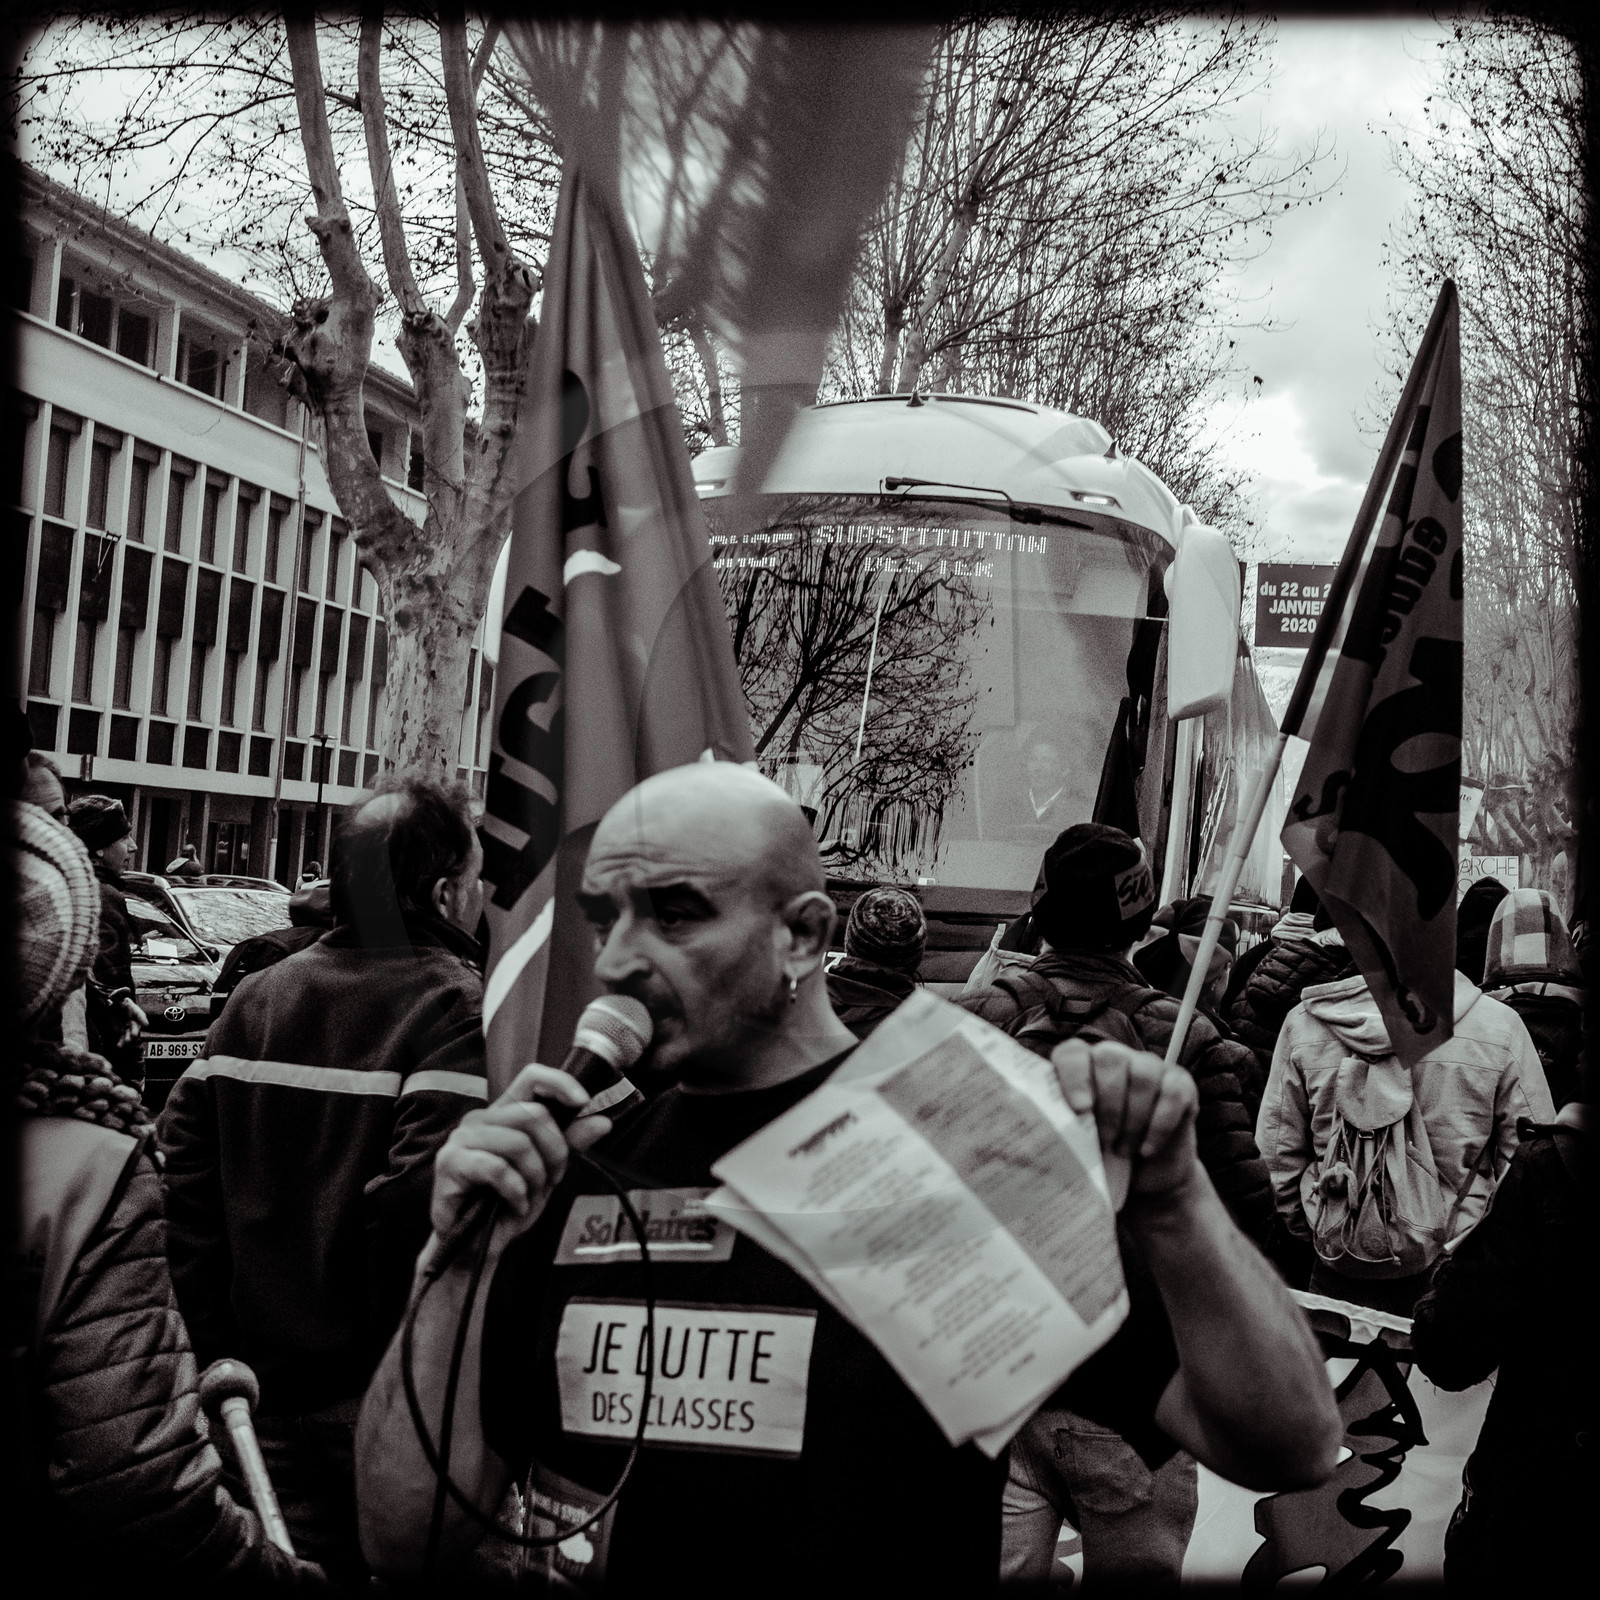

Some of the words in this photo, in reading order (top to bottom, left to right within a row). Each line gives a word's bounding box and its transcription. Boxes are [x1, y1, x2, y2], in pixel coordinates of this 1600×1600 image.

[1260, 581, 1277, 596] du
[1280, 581, 1299, 597] 22
[1302, 585, 1320, 598] au
[1280, 617, 1317, 634] 2020
[582, 1321, 627, 1375] JE
[635, 1324, 776, 1384] LUTTE
[592, 1391, 634, 1425] DES
